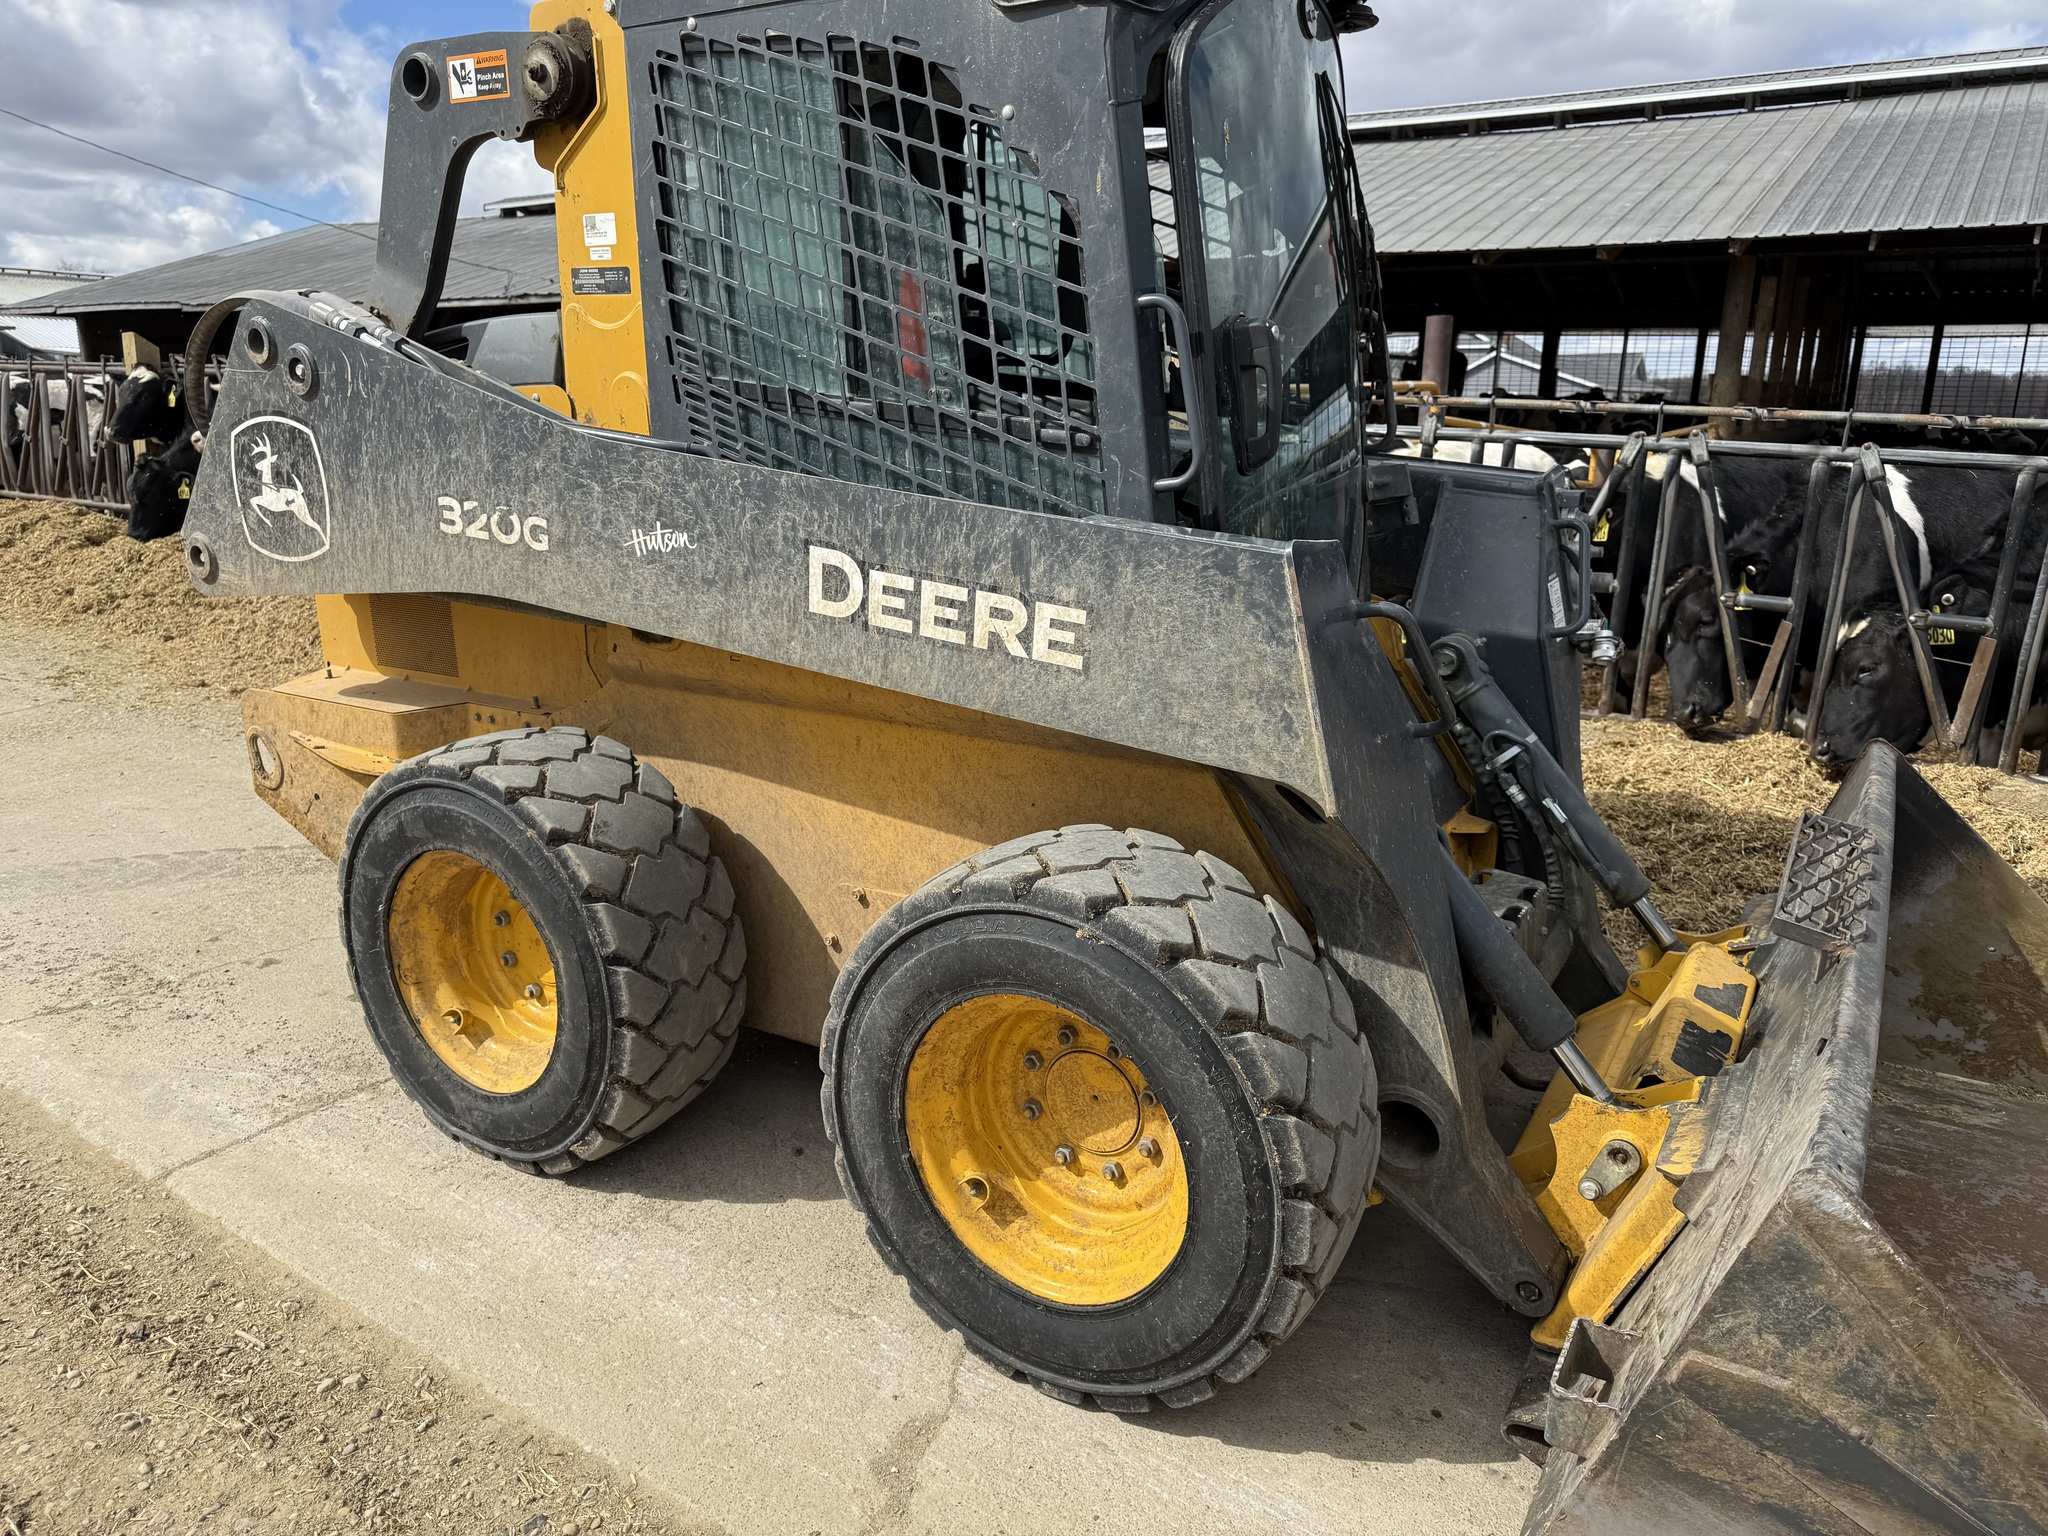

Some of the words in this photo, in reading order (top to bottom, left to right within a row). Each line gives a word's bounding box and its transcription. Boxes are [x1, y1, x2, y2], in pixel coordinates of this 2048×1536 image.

[480, 55, 504, 63] WARNING
[477, 73, 491, 81] Pinch
[492, 72, 505, 80] Area
[477, 83, 489, 91] Keep
[438, 496, 549, 551] 320G
[624, 521, 698, 558] Hutson
[808, 545, 1087, 670] DEERE
